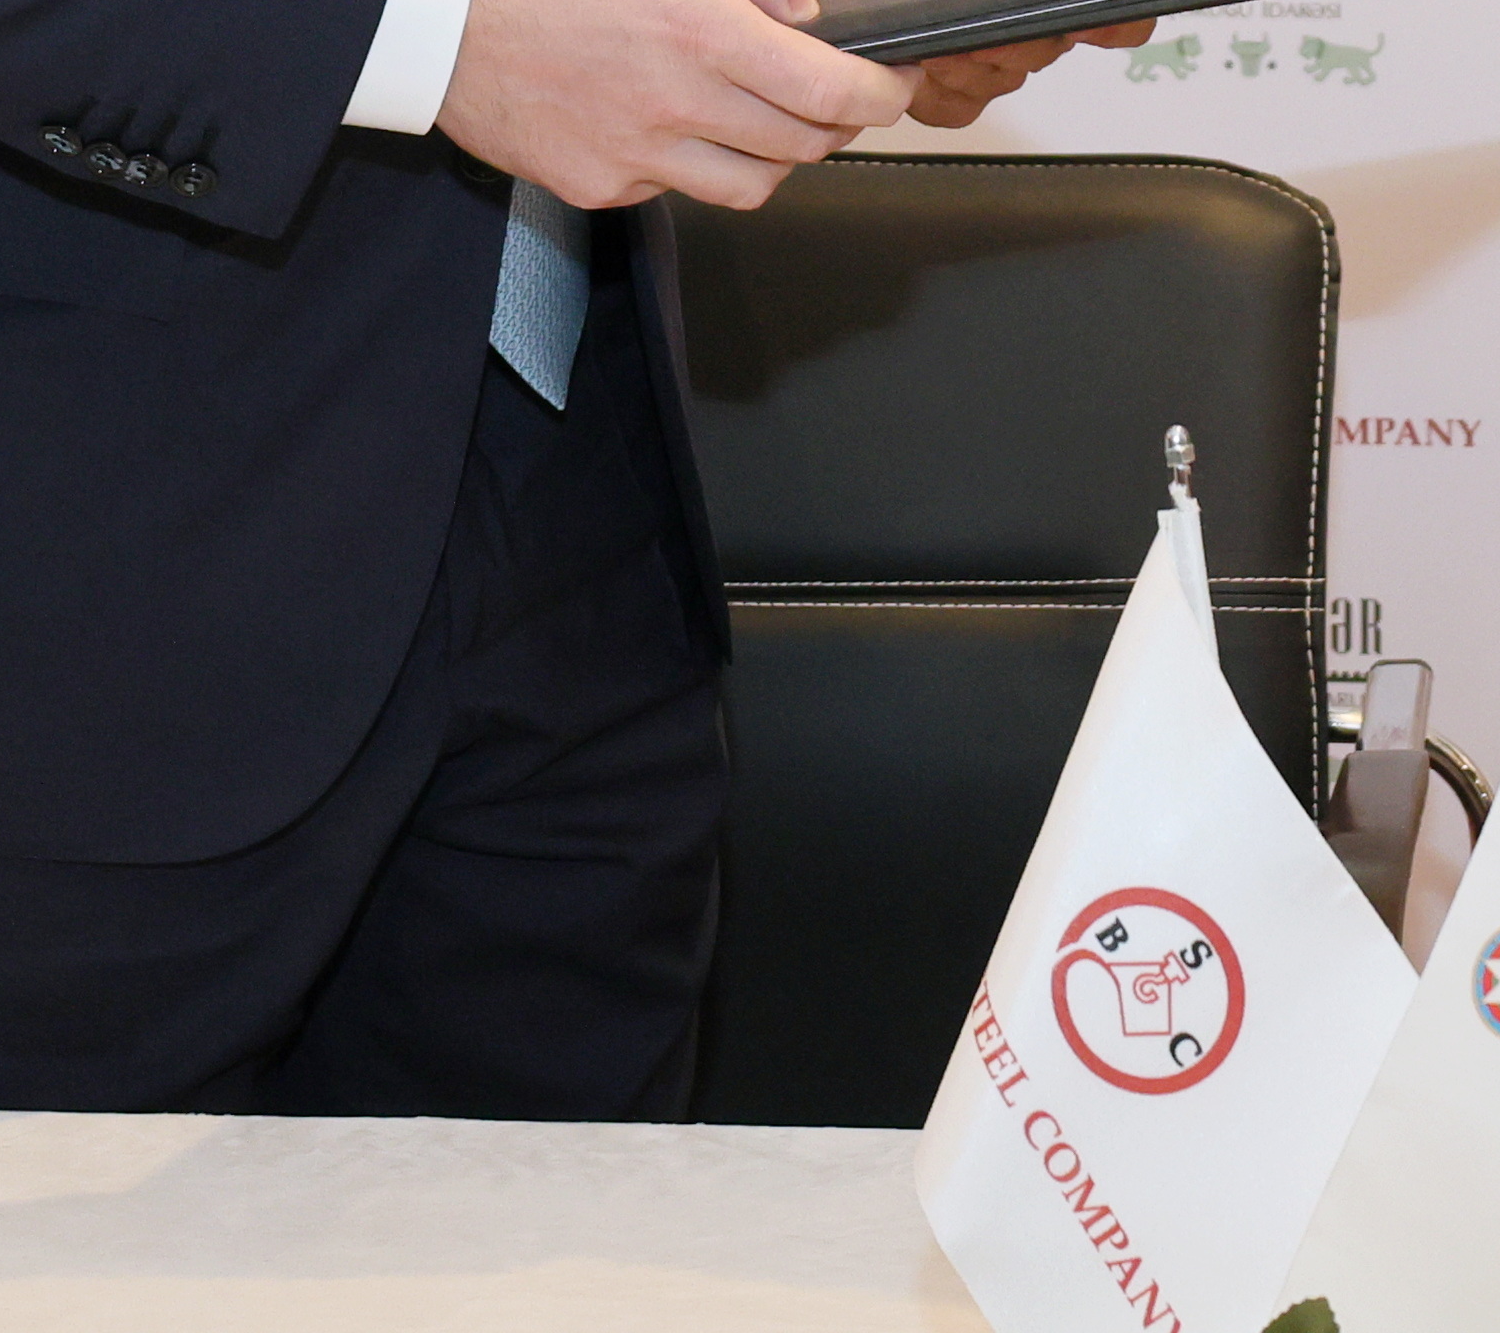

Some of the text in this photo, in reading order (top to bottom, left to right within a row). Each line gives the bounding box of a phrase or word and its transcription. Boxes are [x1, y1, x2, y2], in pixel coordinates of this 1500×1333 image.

[1094, 917, 1213, 970] B S
[972, 981, 1029, 1107] TEEL
[1169, 1032, 1203, 1068] C
